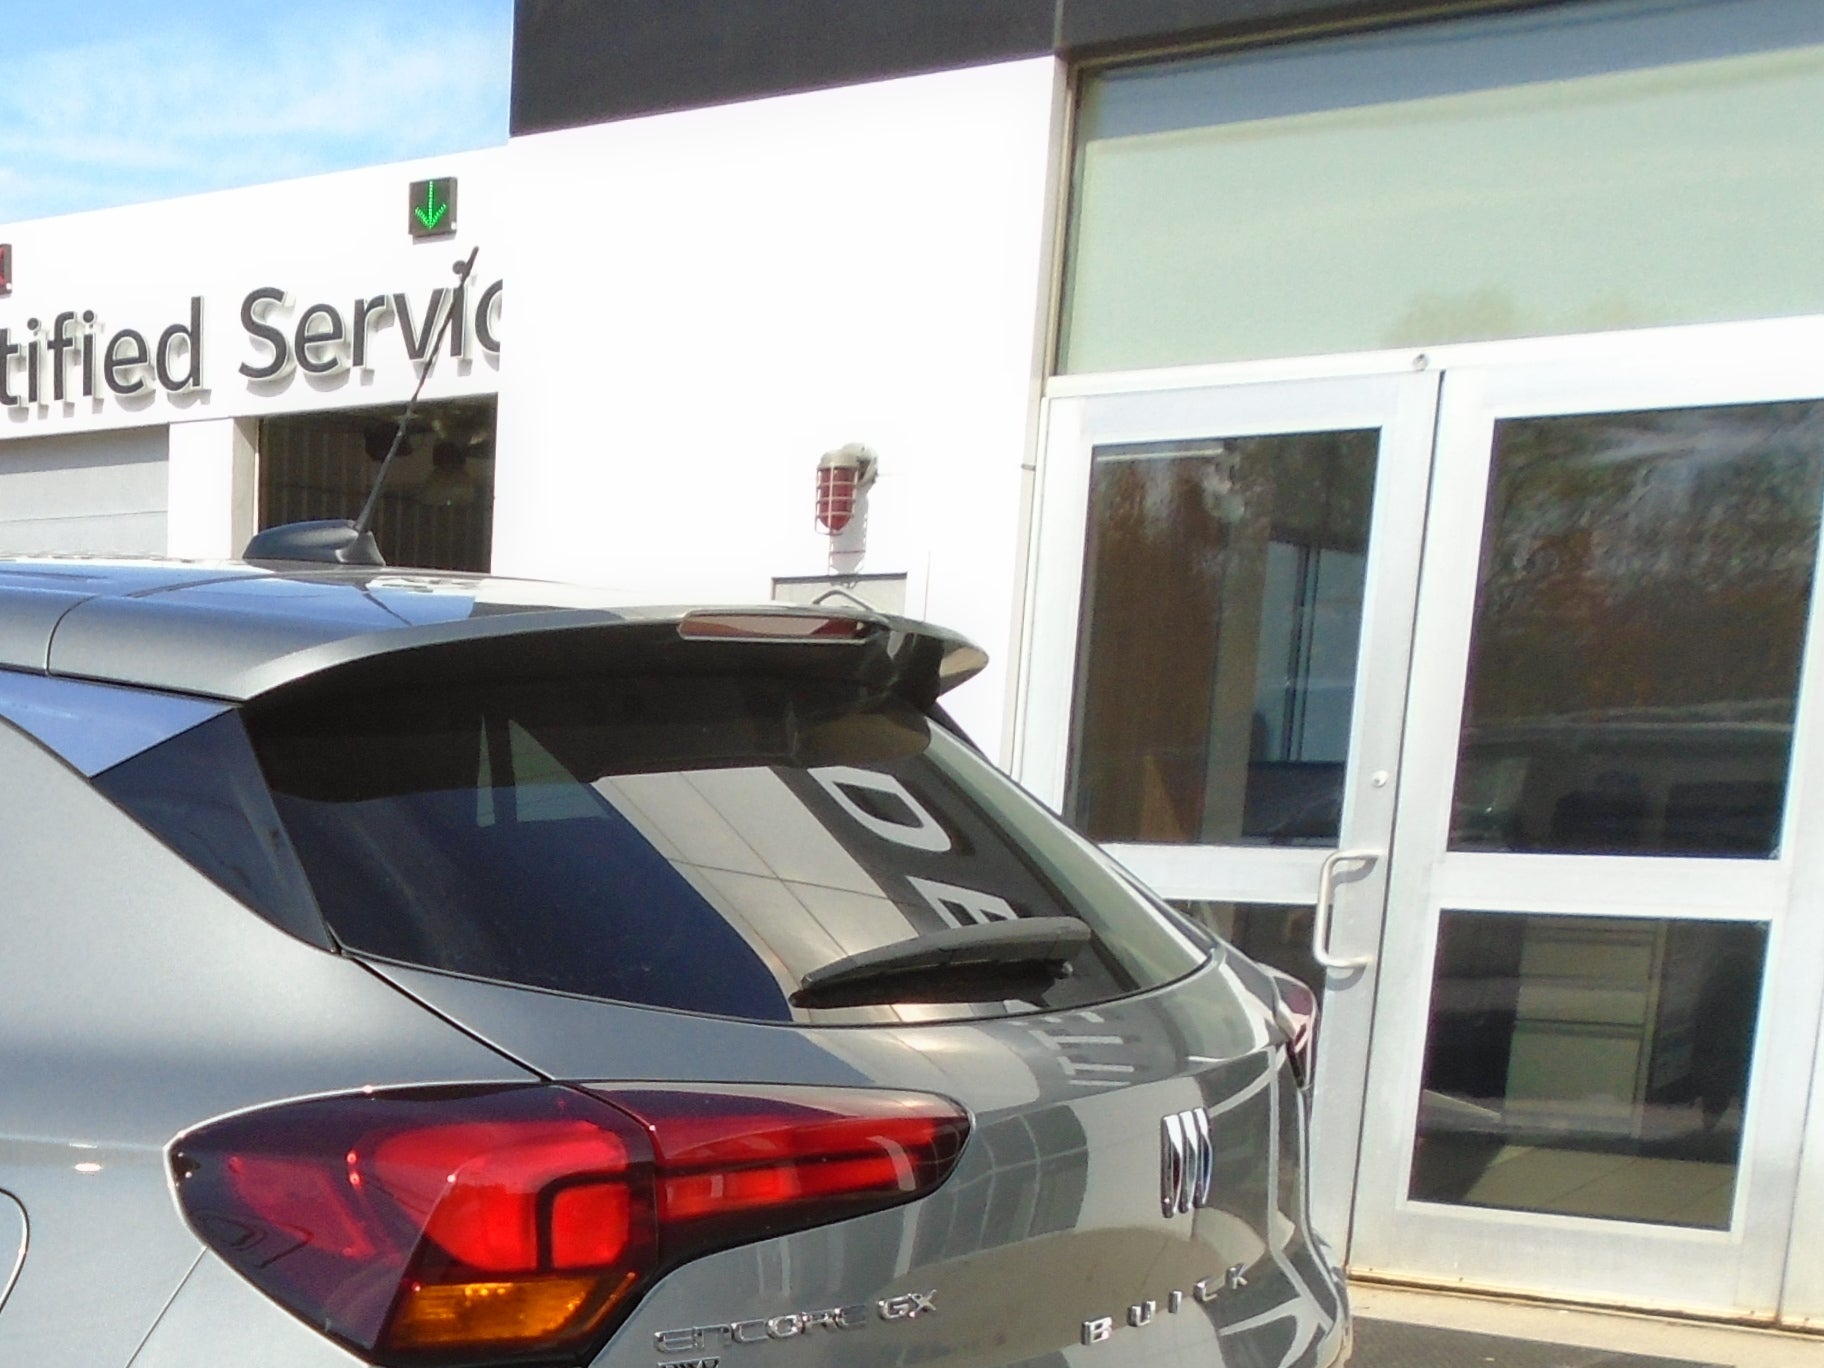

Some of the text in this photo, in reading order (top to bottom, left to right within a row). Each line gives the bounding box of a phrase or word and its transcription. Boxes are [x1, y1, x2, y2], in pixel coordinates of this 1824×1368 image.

[237, 258, 502, 382] Servic
[878, 1289, 937, 1320] GX
[1081, 1262, 1248, 1345] BUICK
